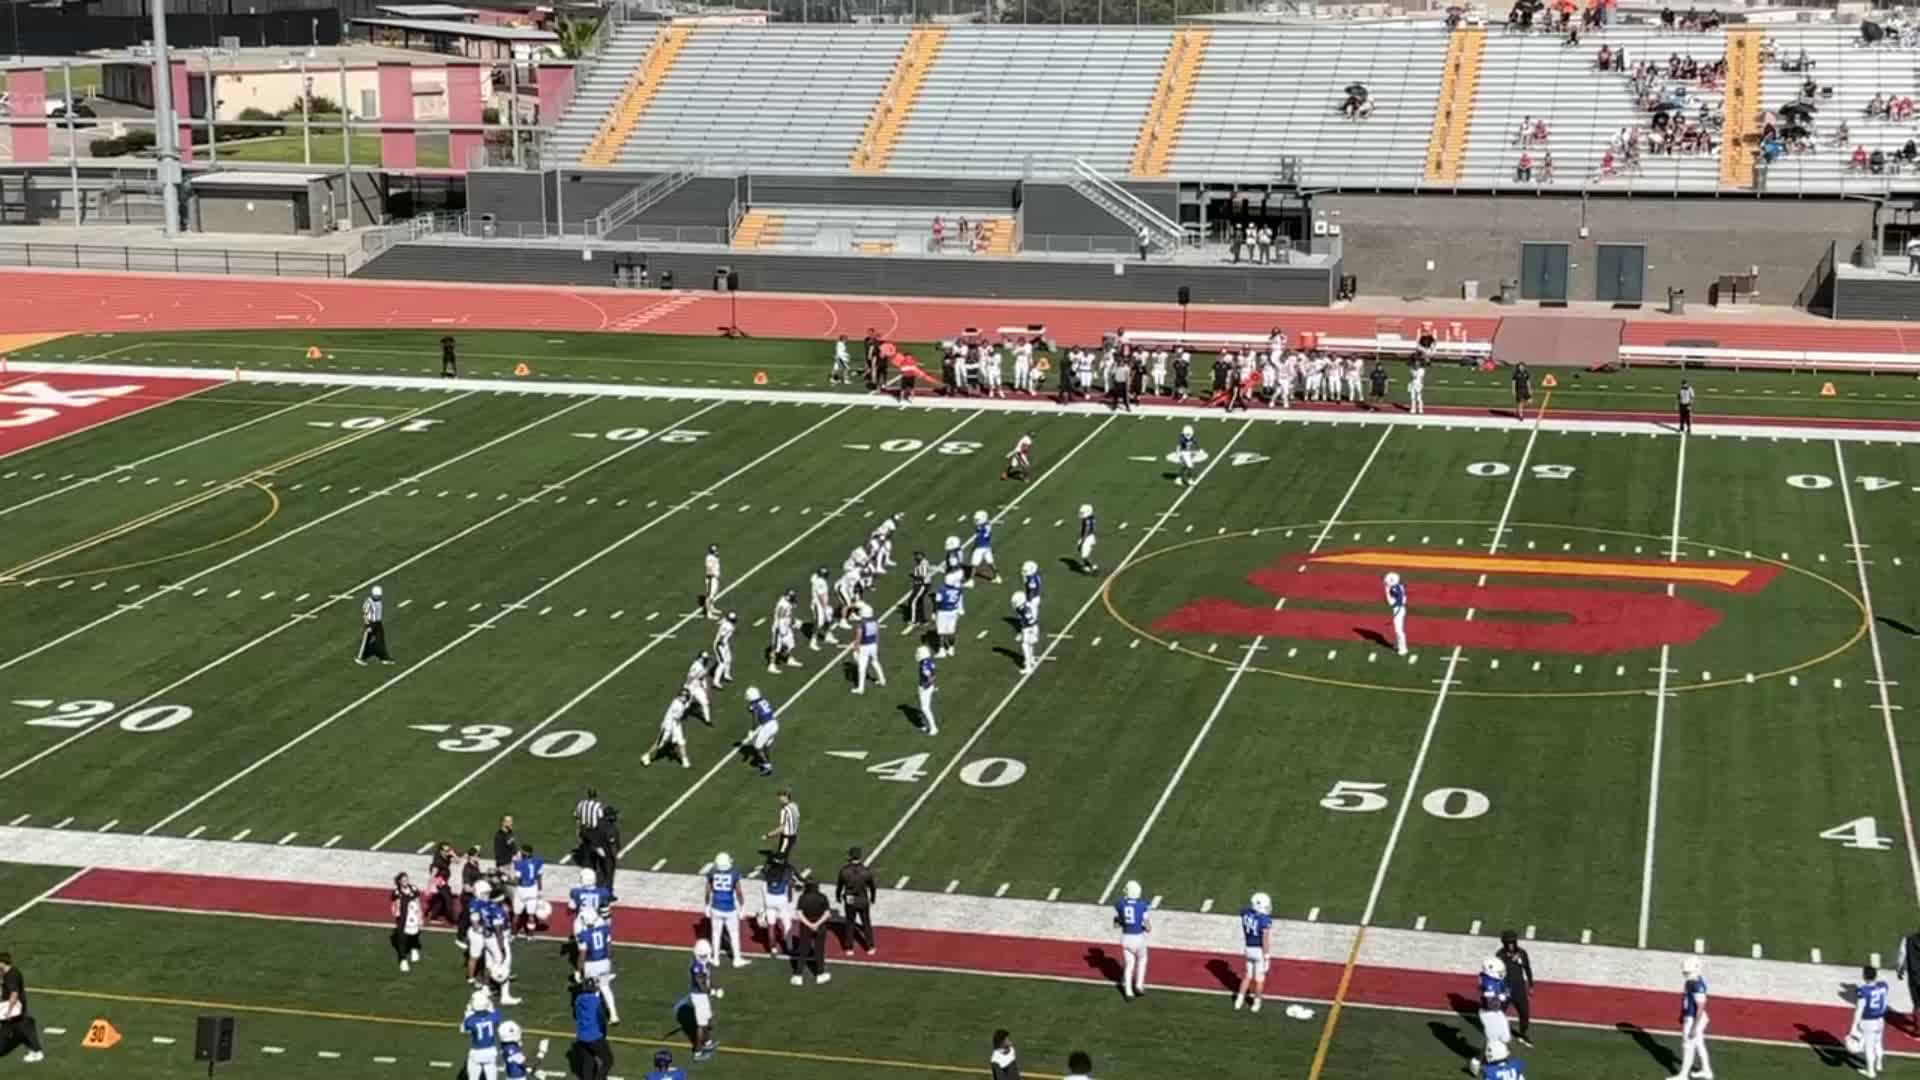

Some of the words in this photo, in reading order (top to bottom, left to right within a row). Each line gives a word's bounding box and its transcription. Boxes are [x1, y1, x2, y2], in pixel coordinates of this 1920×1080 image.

[25, 700, 194, 733] 20
[437, 724, 598, 759] 30
[866, 752, 1028, 788] 40
[1319, 780, 1491, 820] 50
[712, 873, 732, 893] 22
[1123, 906, 1135, 925] 9
[90, 1024, 105, 1043] 30
